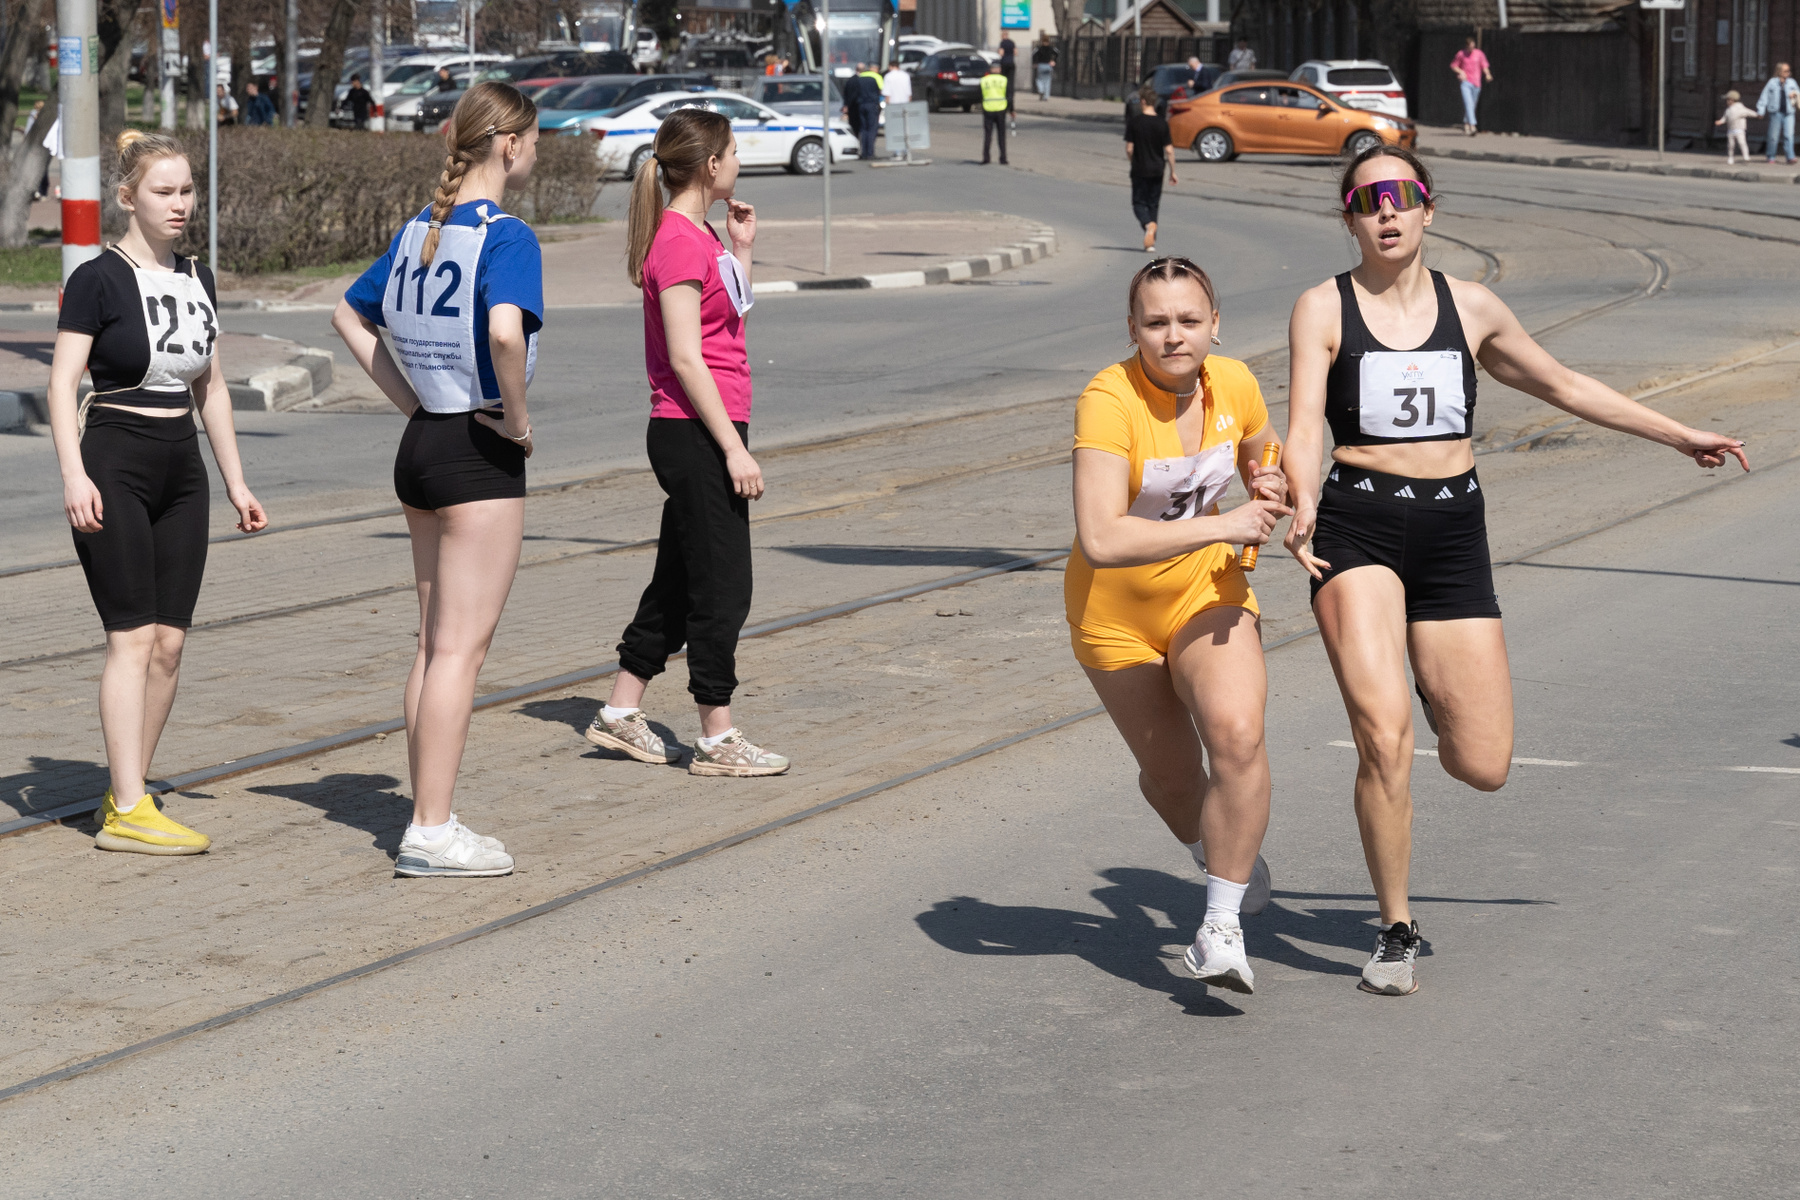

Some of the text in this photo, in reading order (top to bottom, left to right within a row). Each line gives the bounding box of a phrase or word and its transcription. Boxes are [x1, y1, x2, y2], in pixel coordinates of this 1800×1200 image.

[394, 256, 462, 318] 112
[145, 294, 217, 356] 23
[409, 338, 461, 349] государственной
[433, 352, 462, 361] службы
[1391, 386, 1436, 428] 31
[1160, 485, 1207, 521] 31
